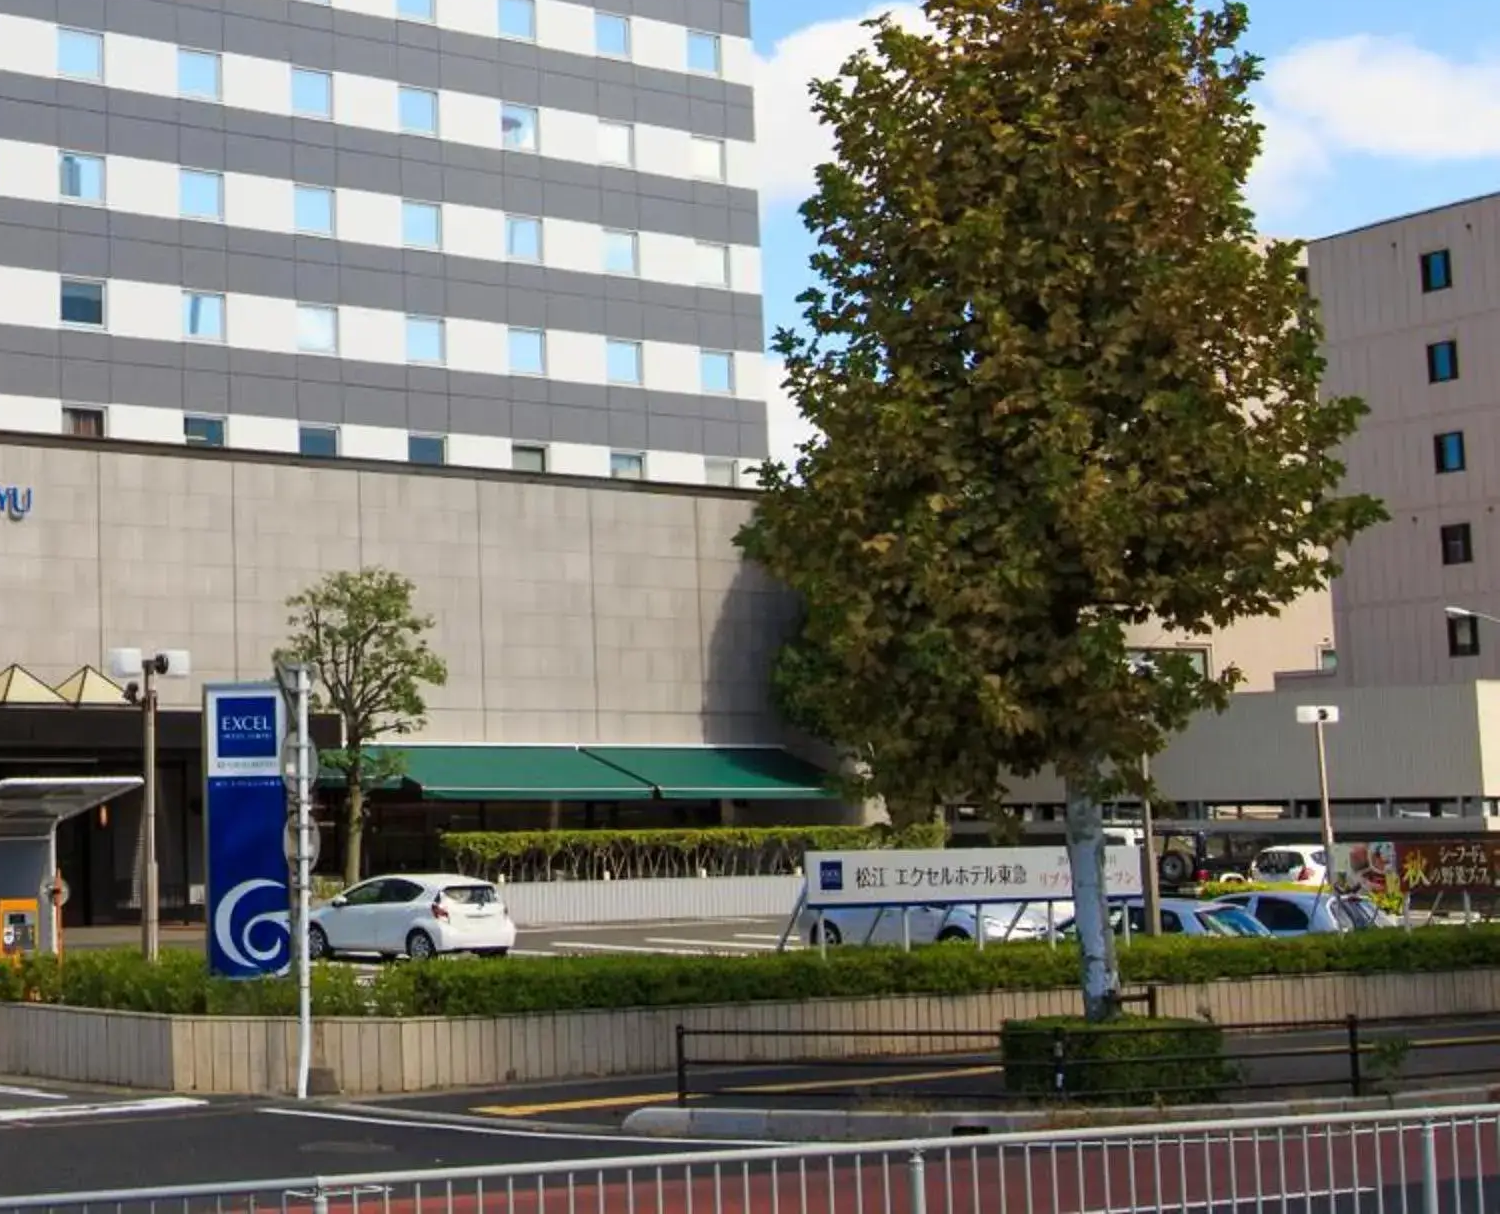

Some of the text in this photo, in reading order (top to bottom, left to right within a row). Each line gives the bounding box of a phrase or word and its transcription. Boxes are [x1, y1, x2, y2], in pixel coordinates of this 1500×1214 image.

[220, 715, 273, 732] EXCEL
[855, 865, 886, 889] 松江
[895, 861, 1028, 888] エクセルホテル東急
